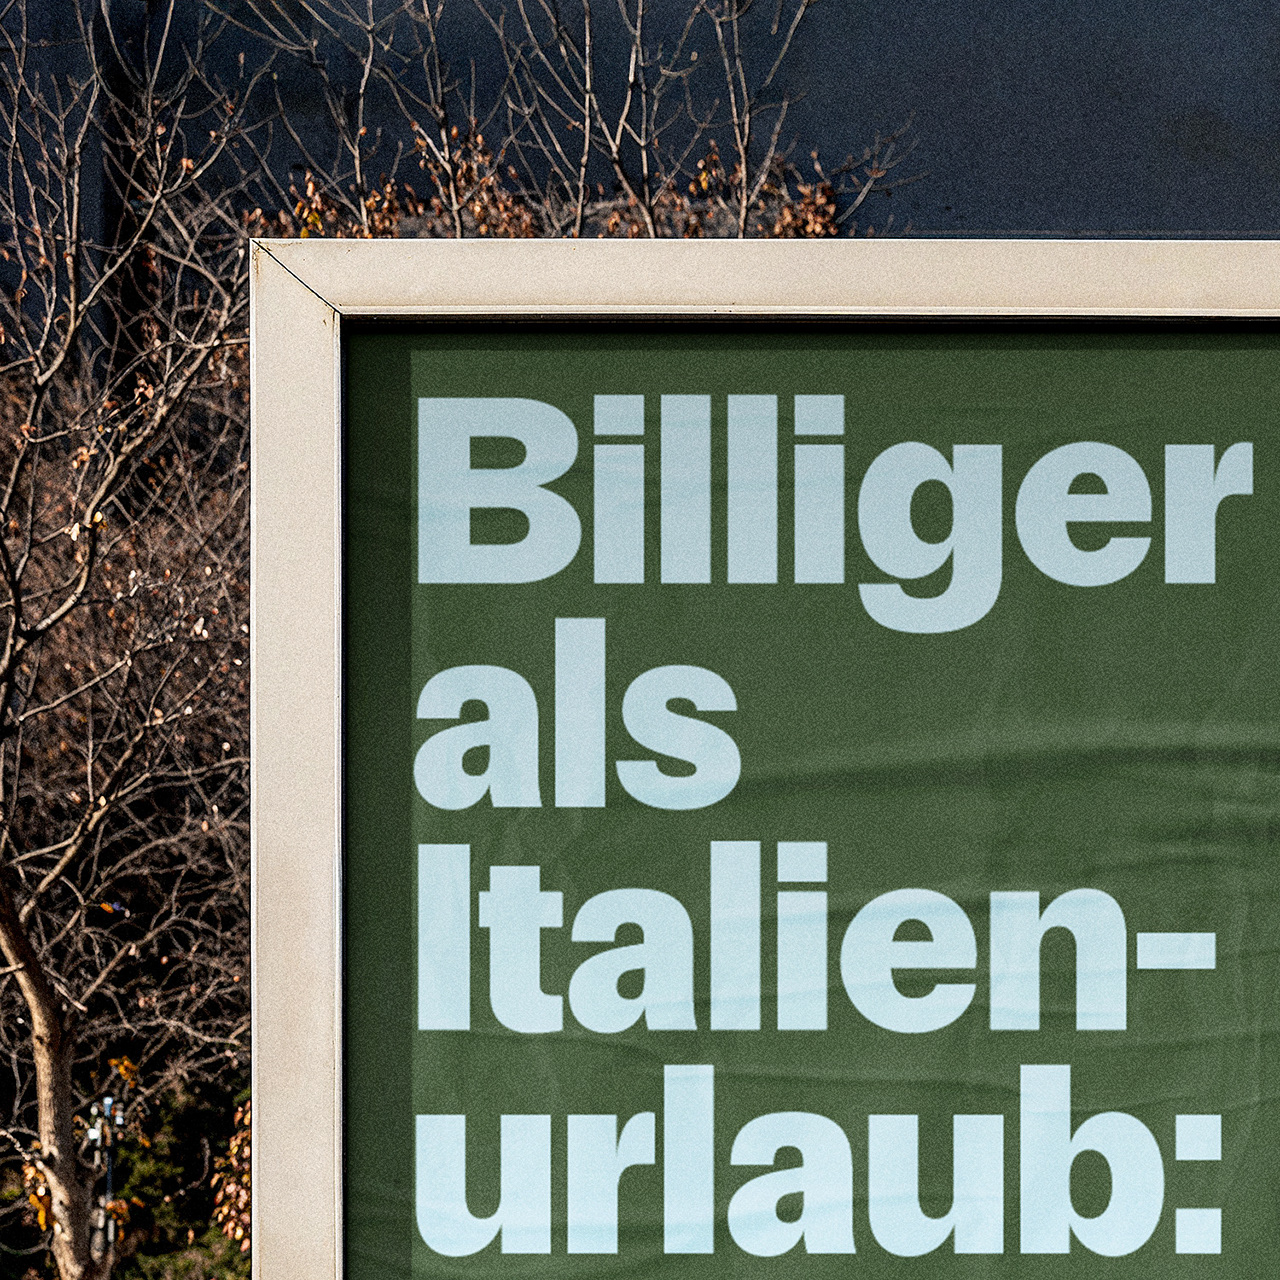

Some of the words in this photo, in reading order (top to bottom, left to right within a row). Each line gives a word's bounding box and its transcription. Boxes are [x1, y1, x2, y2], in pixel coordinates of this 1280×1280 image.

[418, 395, 1254, 633] Billiger
[413, 618, 742, 811] als
[418, 841, 1217, 1034] Italien-
[415, 1064, 1222, 1257] urlaub:
